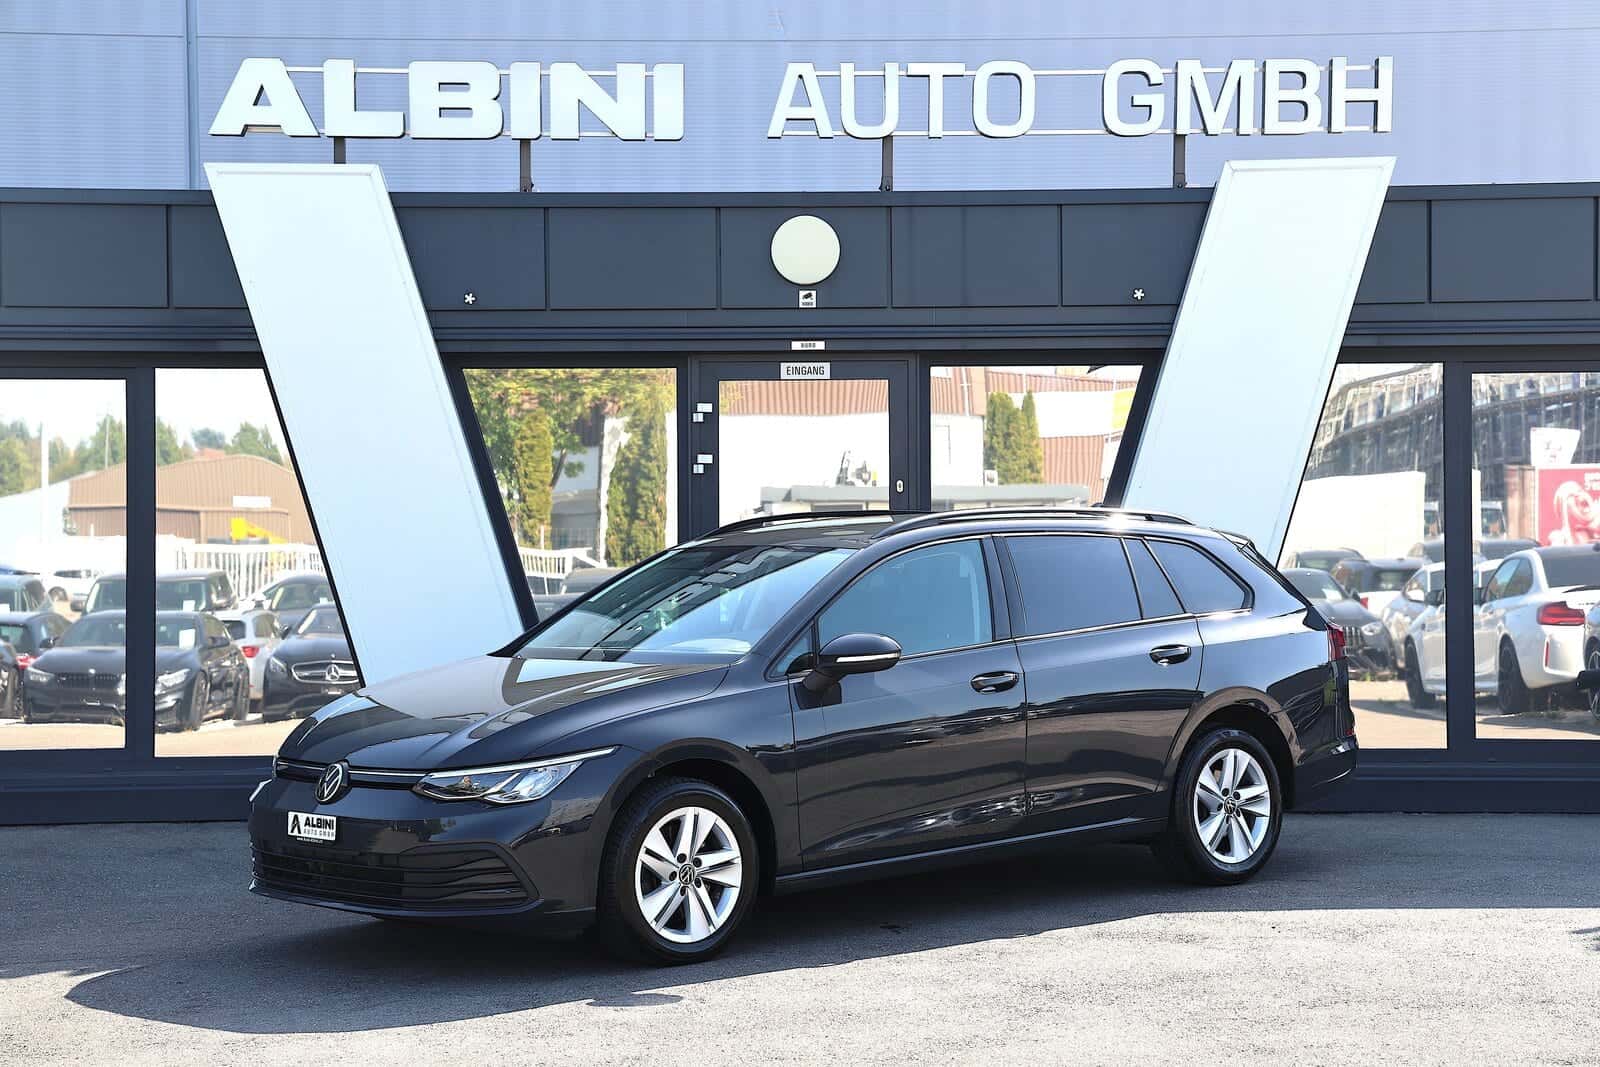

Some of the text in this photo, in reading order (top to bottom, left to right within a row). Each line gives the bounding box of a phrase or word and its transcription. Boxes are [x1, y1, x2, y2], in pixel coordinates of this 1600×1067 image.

[208, 55, 1394, 141] ALBINI AUTO GMBH
[786, 366, 825, 376] EINGANG
[304, 816, 334, 830] ALBINI
